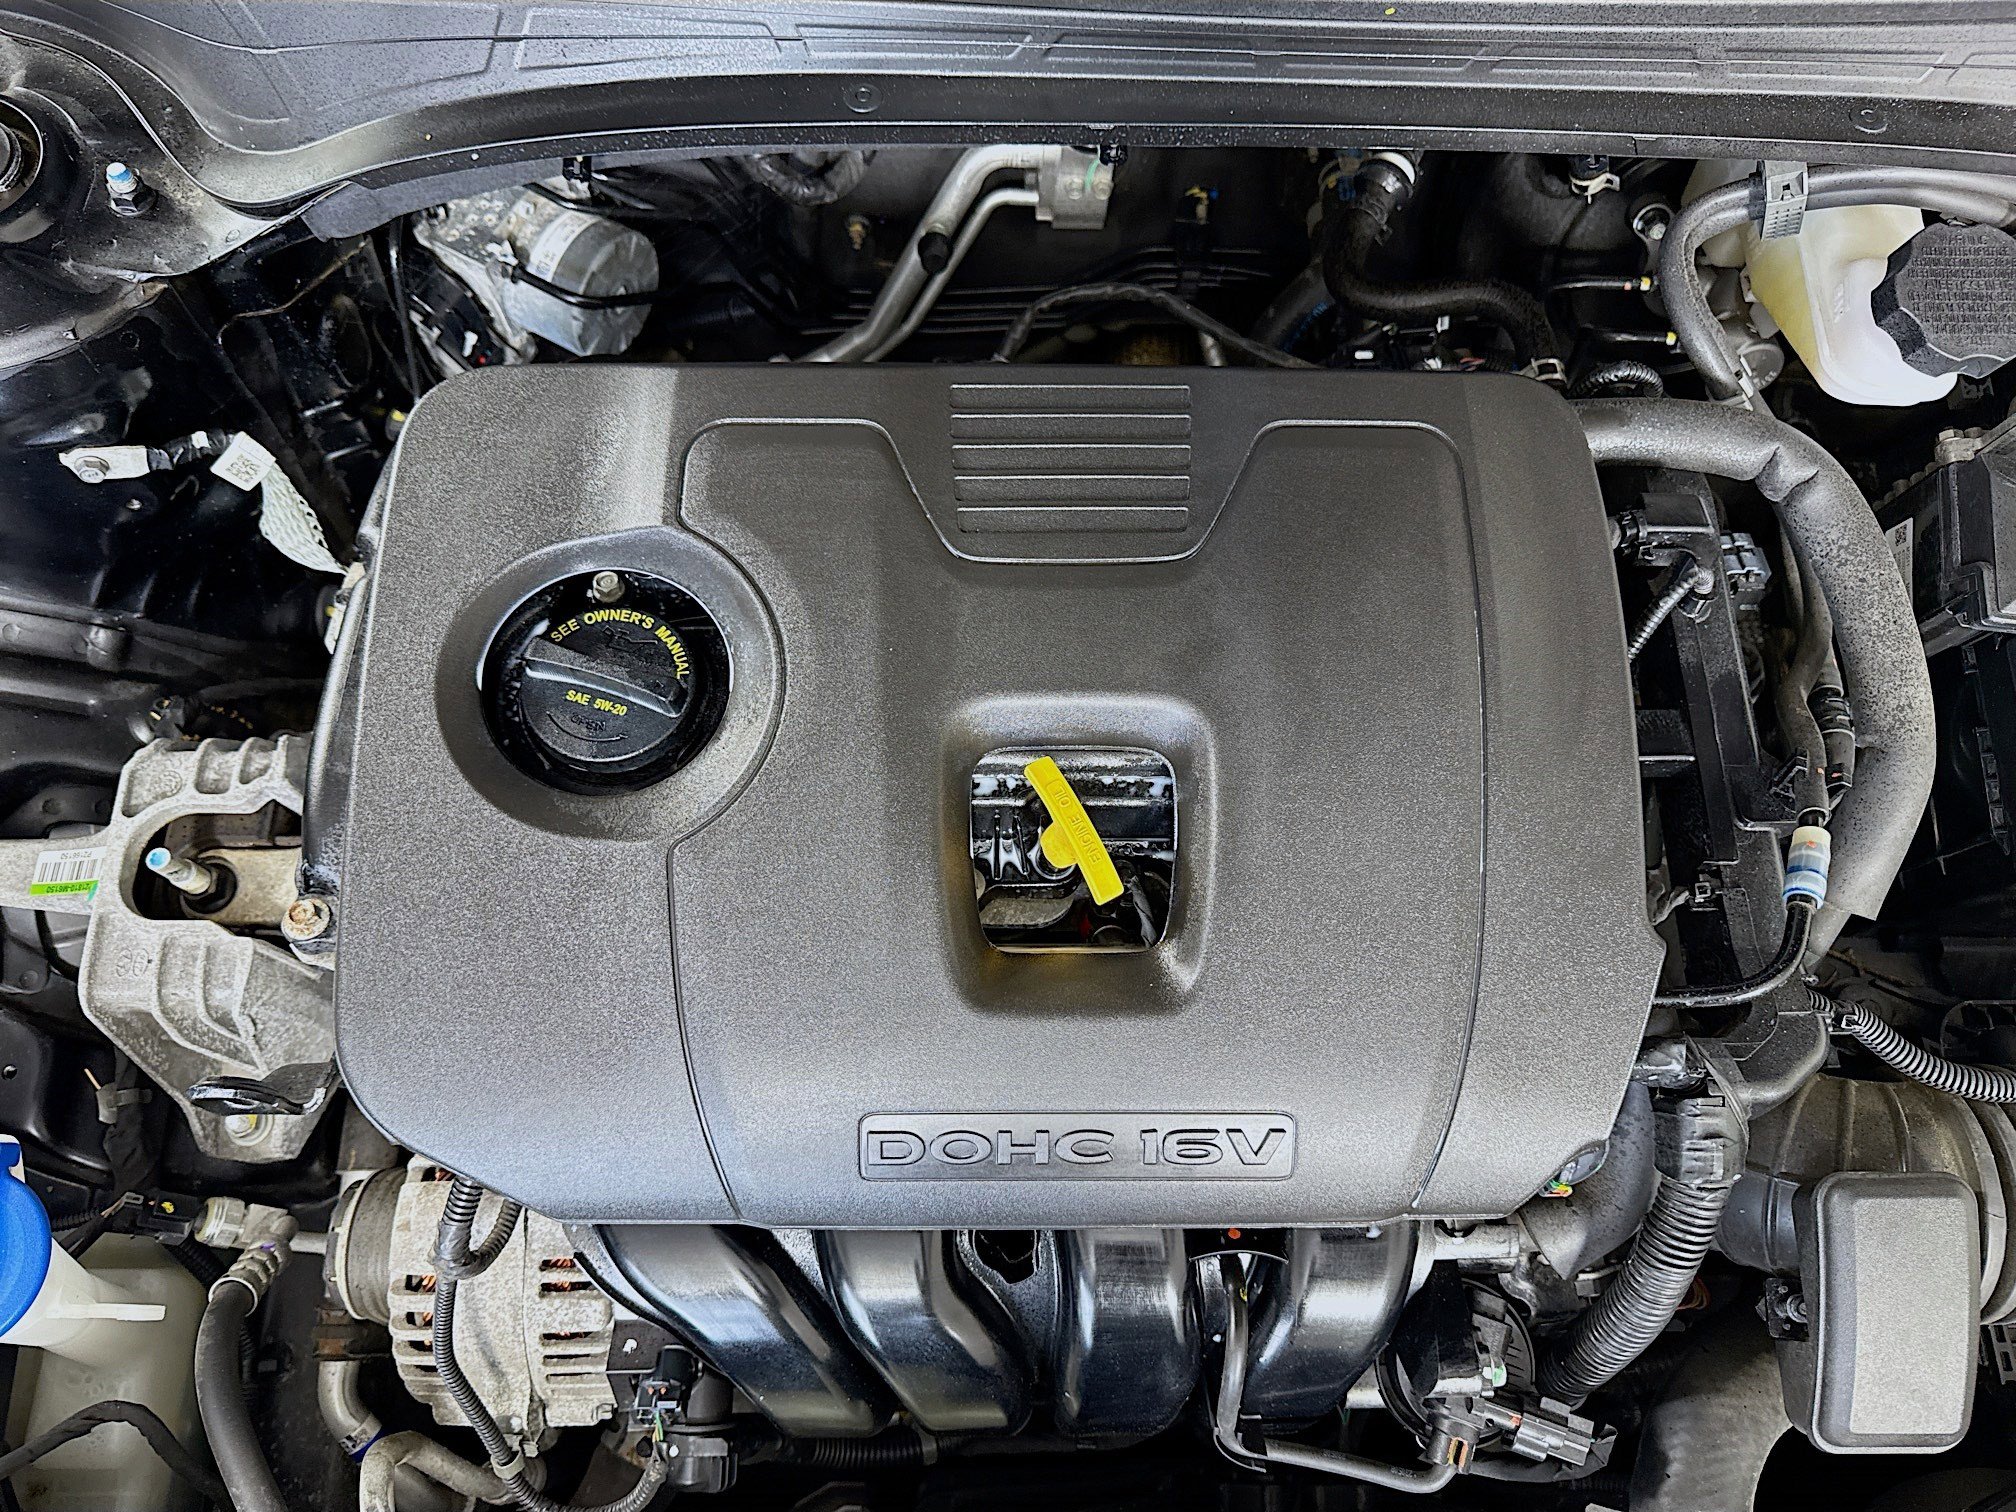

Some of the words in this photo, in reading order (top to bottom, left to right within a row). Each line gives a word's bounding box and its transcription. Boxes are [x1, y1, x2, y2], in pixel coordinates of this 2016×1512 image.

[551, 619, 580, 642] SEE
[584, 609, 655, 629] OWNER'S
[655, 626, 690, 679] MANUAL
[566, 690, 591, 705] SAE
[593, 698, 627, 716] 5W-20
[1053, 787, 1071, 808] OIL
[1071, 815, 1101, 863] ENGINE
[867, 1129, 1115, 1165] DOHC
[1140, 1128, 1287, 1165] 16V
